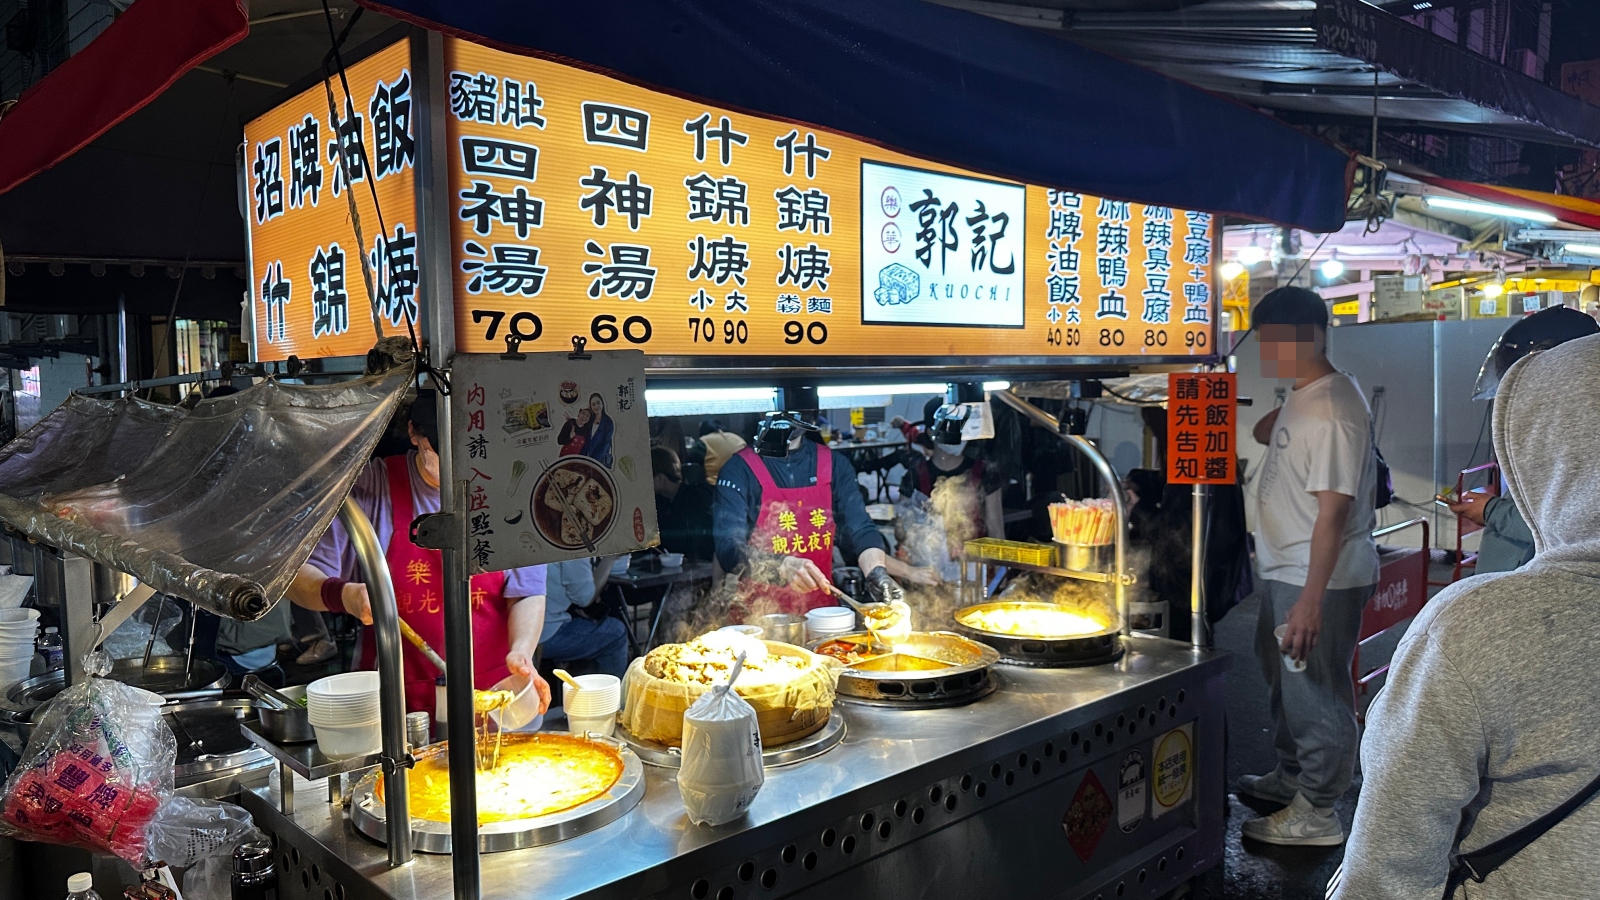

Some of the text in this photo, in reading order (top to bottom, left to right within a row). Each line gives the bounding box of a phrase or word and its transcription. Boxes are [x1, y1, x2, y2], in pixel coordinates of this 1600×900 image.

[449, 70, 547, 130] 豬肚
[254, 68, 415, 225] 招牌油飯
[578, 101, 658, 300] 四神湯
[458, 135, 549, 297] 四神湯
[908, 188, 1015, 276] 郭記
[689, 289, 750, 314] 小 大
[929, 282, 1011, 301] KUOCHI
[472, 309, 543, 342] 70
[590, 314, 653, 344] 60
[1046, 306, 1081, 325] 小 大
[688, 317, 749, 344] 70 90
[783, 320, 828, 345] 90
[1047, 328, 1081, 346] 40 50
[1099, 328, 1125, 346] 80
[1144, 329, 1168, 346] 80
[1184, 330, 1207, 347] 90
[616, 384, 632, 411] 郭記
[1174, 378, 1200, 479] 請先告知
[1204, 376, 1229, 479] 油飯加醬
[778, 508, 828, 532] 樂華
[771, 529, 833, 555] 觀光夜市
[405, 558, 433, 586] 樂
